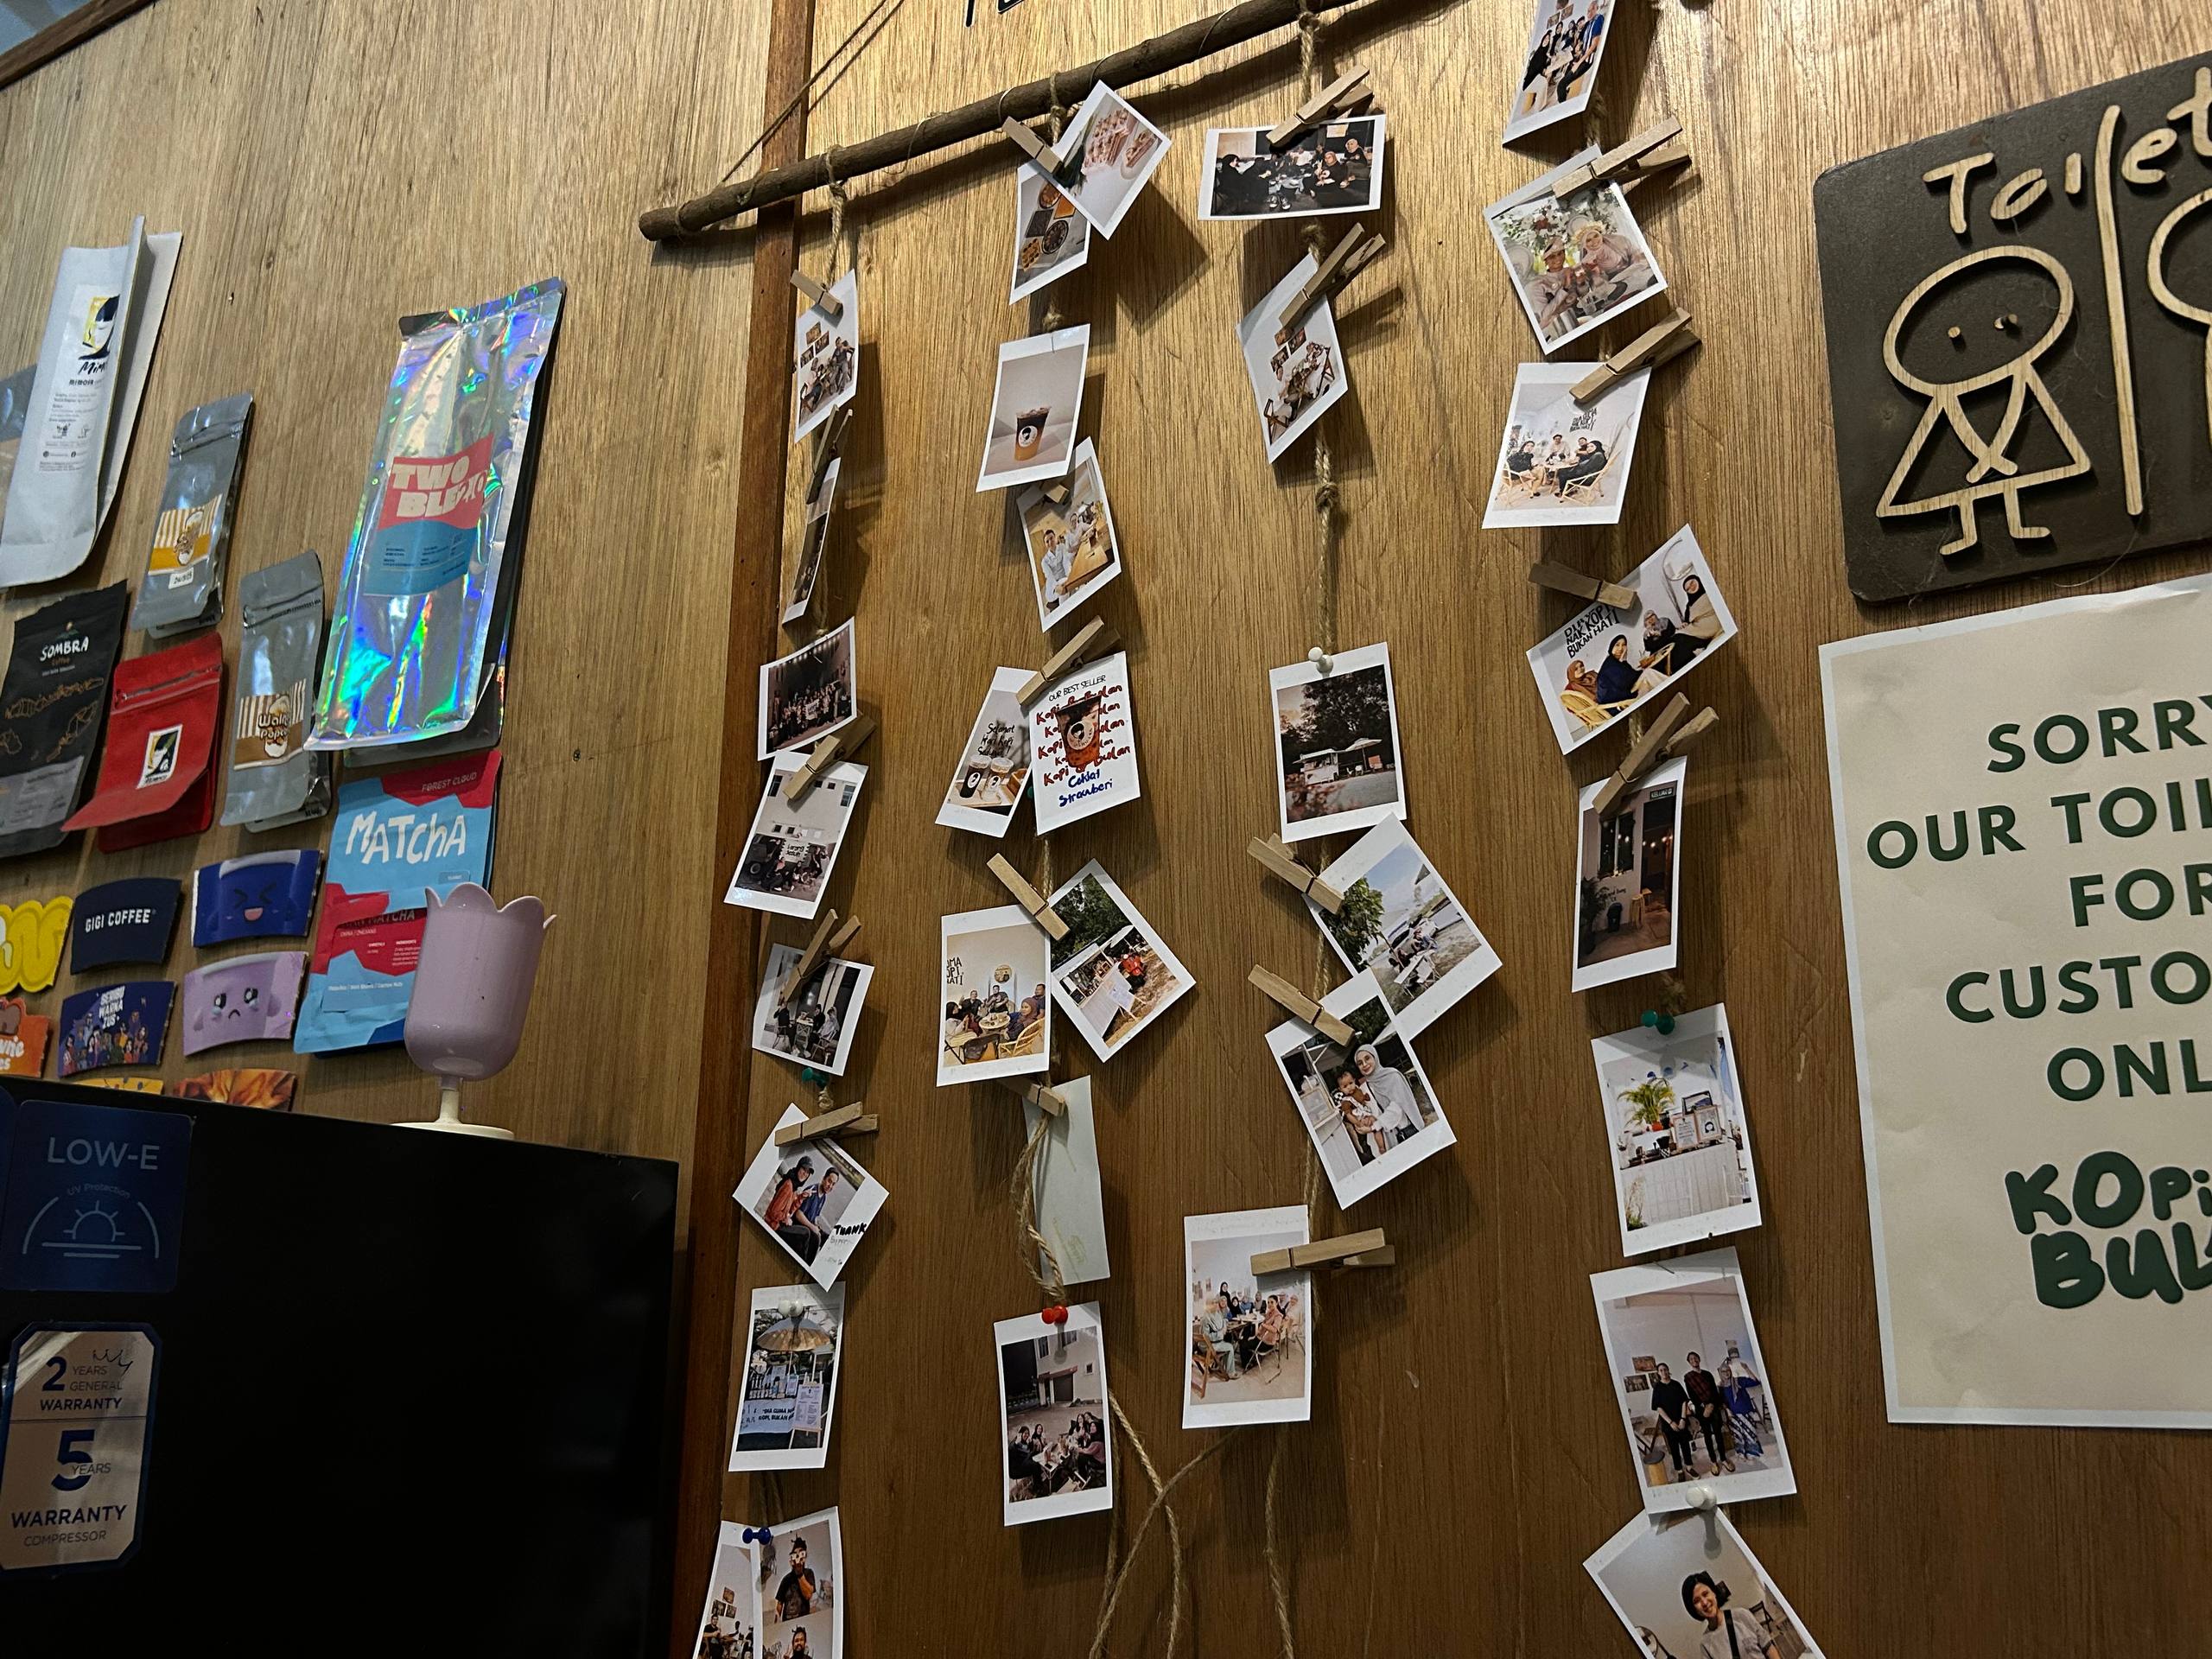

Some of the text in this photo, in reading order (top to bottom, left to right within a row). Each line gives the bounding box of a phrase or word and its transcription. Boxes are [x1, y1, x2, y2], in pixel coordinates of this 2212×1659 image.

[391, 455, 470, 490] TWO
[1567, 632, 1593, 659] BUKAN
[1592, 608, 1621, 637] HATI
[40, 636, 89, 663] SOMBRA
[1048, 674, 1106, 702] OUR BEST SELLER
[1038, 738, 1063, 760] Kopi
[422, 772, 478, 792] FOREST CLOUD
[1043, 765, 1070, 787] Kopi
[1866, 804, 2027, 870] OUR
[2069, 861, 2212, 928] FOR
[86, 908, 151, 933] GIGI COFFEE
[1945, 950, 2212, 1023] CUSTO
[2046, 1039, 2212, 1102] ONL
[48, 1136, 160, 1170] LOW-E
[67, 1185, 81, 1196] UV
[834, 1222, 868, 1236] THANK
[2030, 1221, 2212, 1310] BUL
[41, 1356, 108, 1392] 2 YEARS
[69, 1381, 124, 1392] GENERAL
[40, 1397, 123, 1412] WARRANTY
[51, 1428, 111, 1492] 5 YEARS
[11, 1504, 127, 1529] WARRANTY
[23, 1530, 107, 1547] COMPRESSOR
